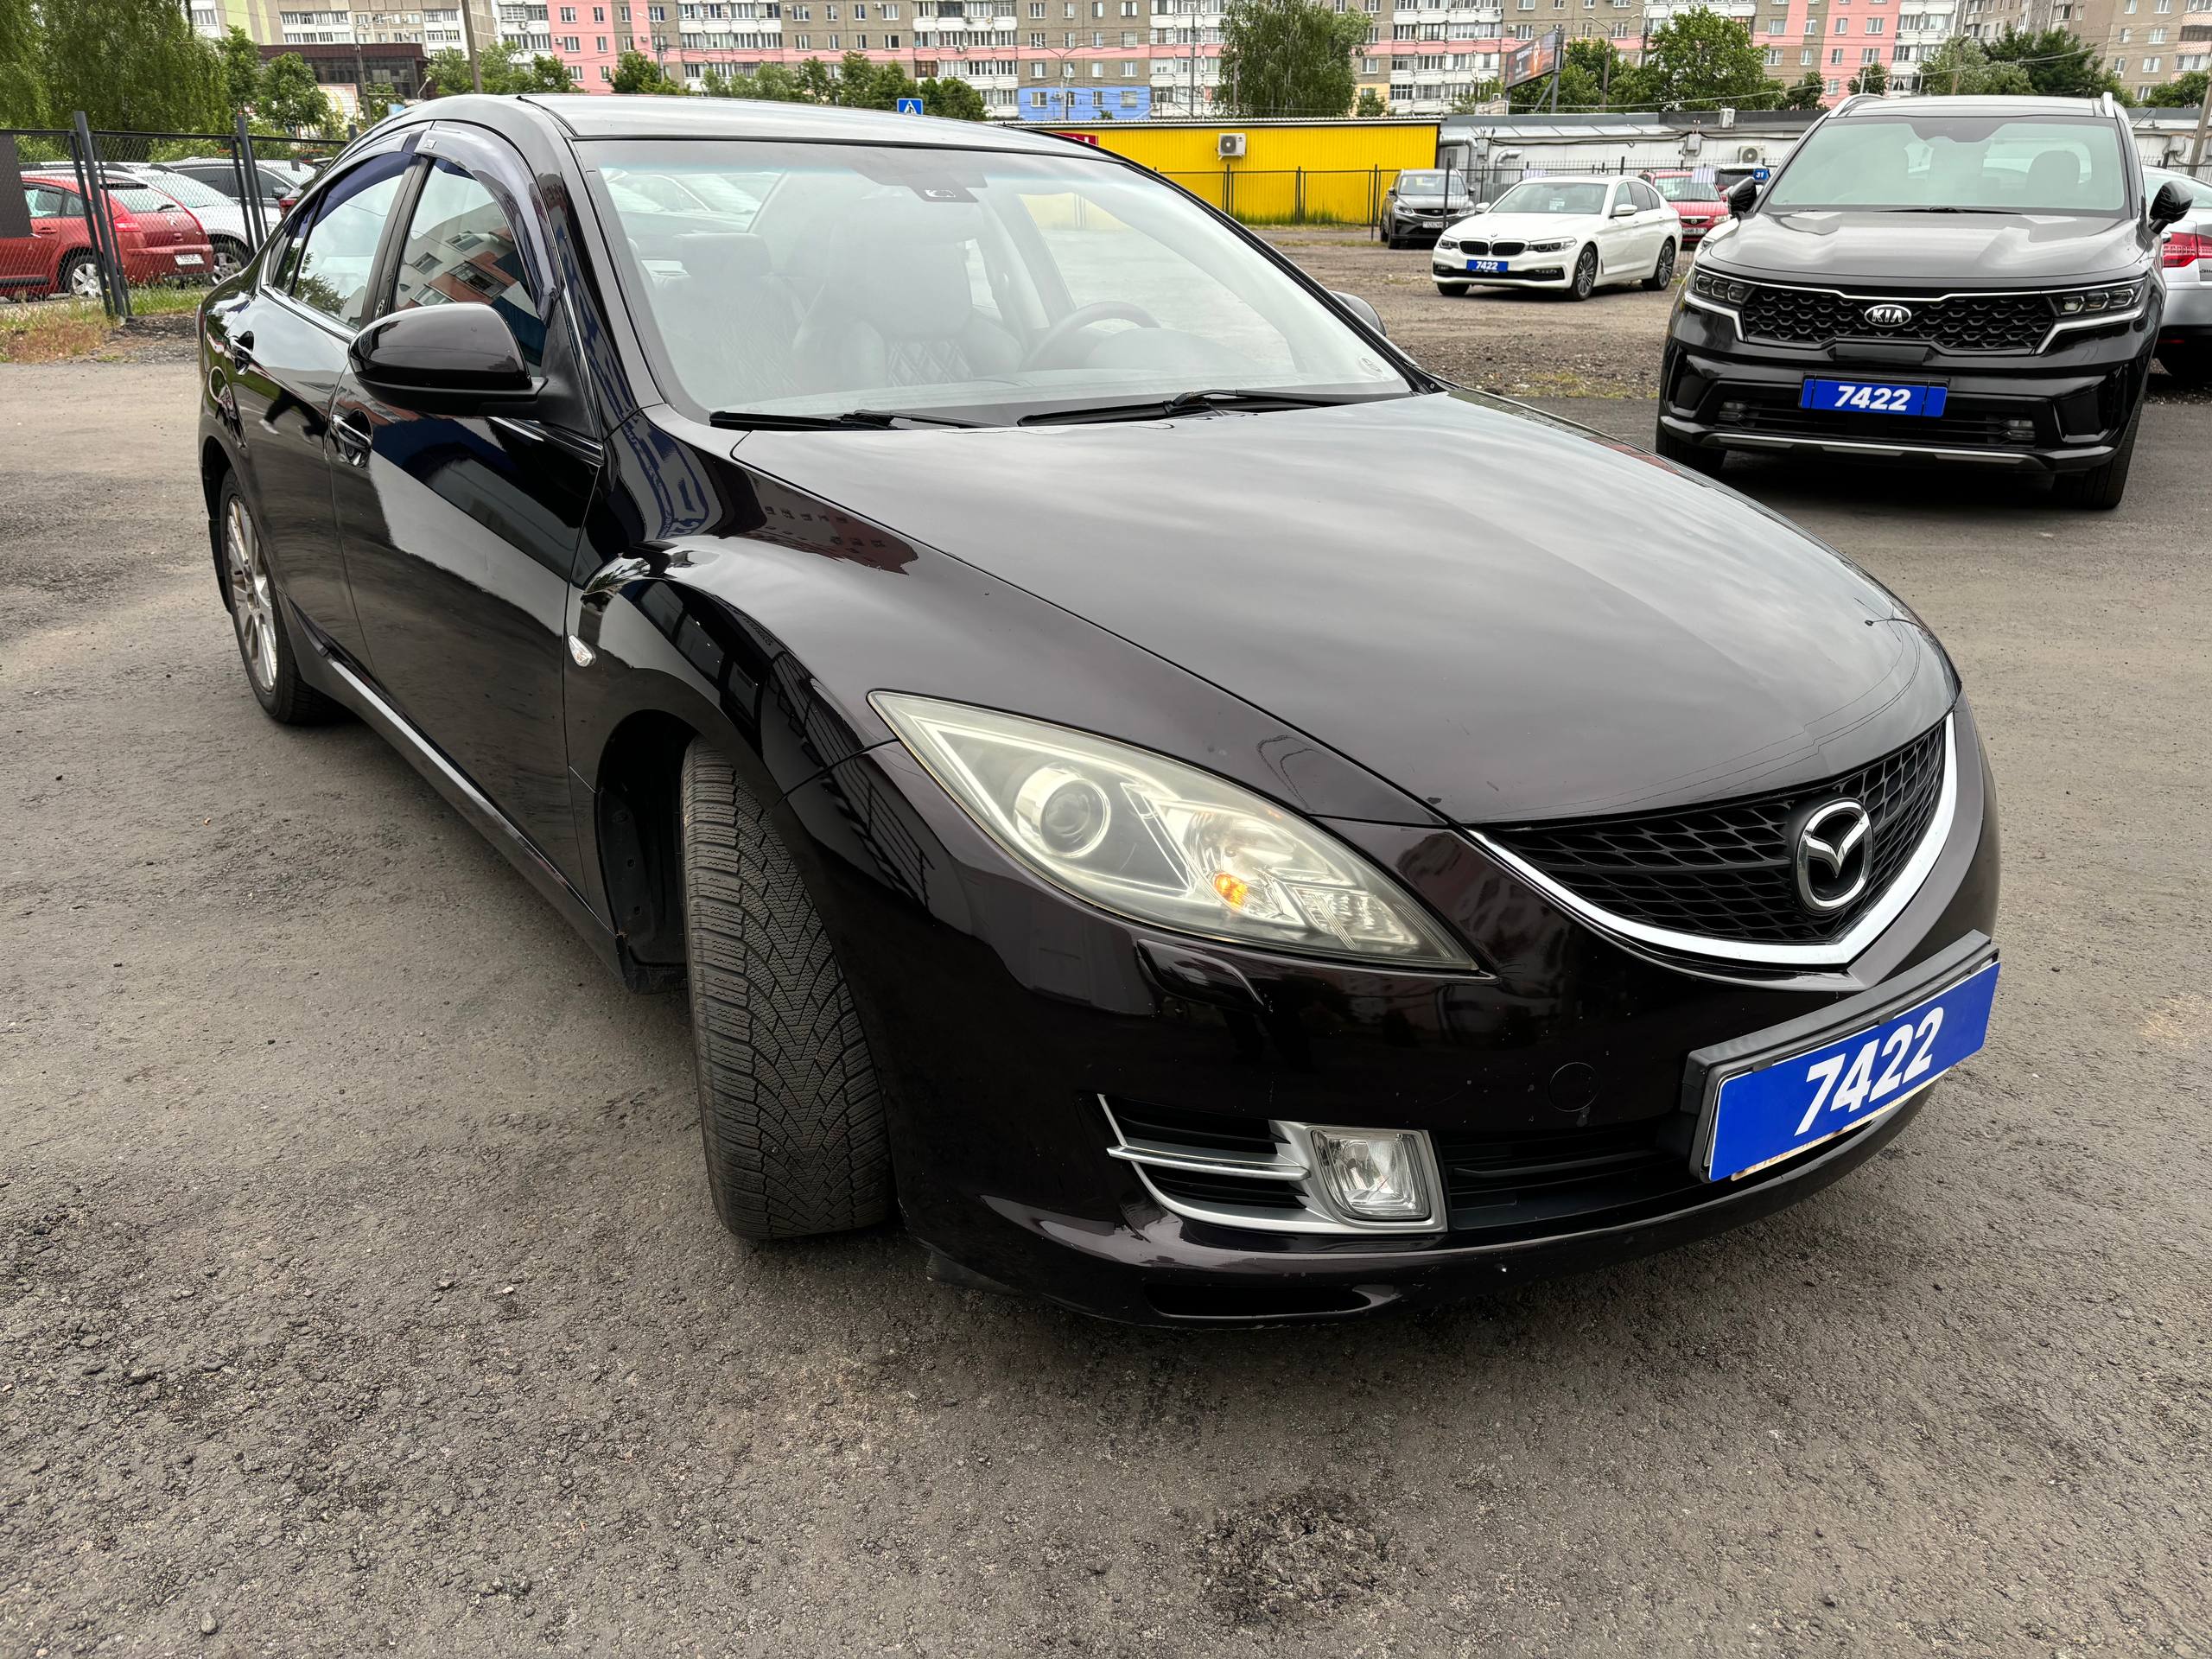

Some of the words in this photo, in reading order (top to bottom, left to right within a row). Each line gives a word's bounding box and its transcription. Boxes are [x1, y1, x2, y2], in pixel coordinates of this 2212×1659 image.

[1476, 261, 1498, 270] 7422
[1872, 308, 1903, 323] KIA
[1834, 385, 1911, 411] 7422
[1794, 1007, 1944, 1136] 7422
